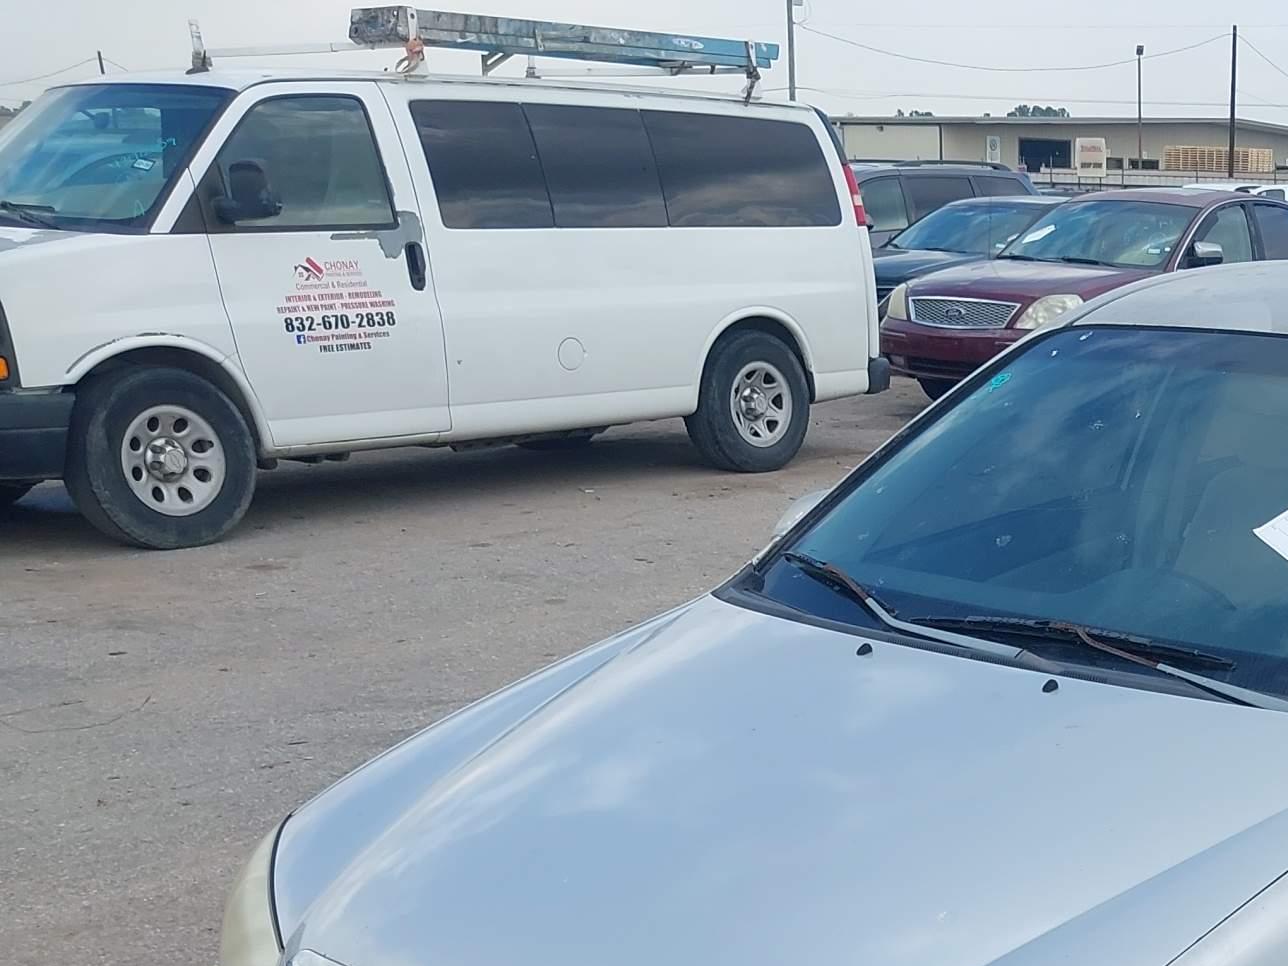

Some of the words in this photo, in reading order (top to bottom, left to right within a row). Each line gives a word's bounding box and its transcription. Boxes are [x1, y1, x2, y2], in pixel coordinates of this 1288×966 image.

[324, 260, 359, 271] CHONAY
[295, 281, 330, 290] Commercial
[331, 281, 336, 289] &
[337, 280, 368, 289] Residential
[285, 294, 312, 303] INTERIOR
[318, 292, 344, 301] EXTERIOR
[348, 291, 382, 299] REMODELING
[277, 305, 301, 314] REPAINT
[307, 303, 320, 312] NEW
[321, 302, 337, 311] PAINT
[340, 301, 369, 310] PRESSURE
[369, 300, 395, 308] WASHING
[284, 311, 396, 333] 832-670-2838
[306, 334, 330, 343] Chonay
[331, 332, 357, 341] Painting
[363, 331, 390, 339] Services
[319, 344, 336, 353] FREE
[336, 342, 372, 351] ESTIMATES
